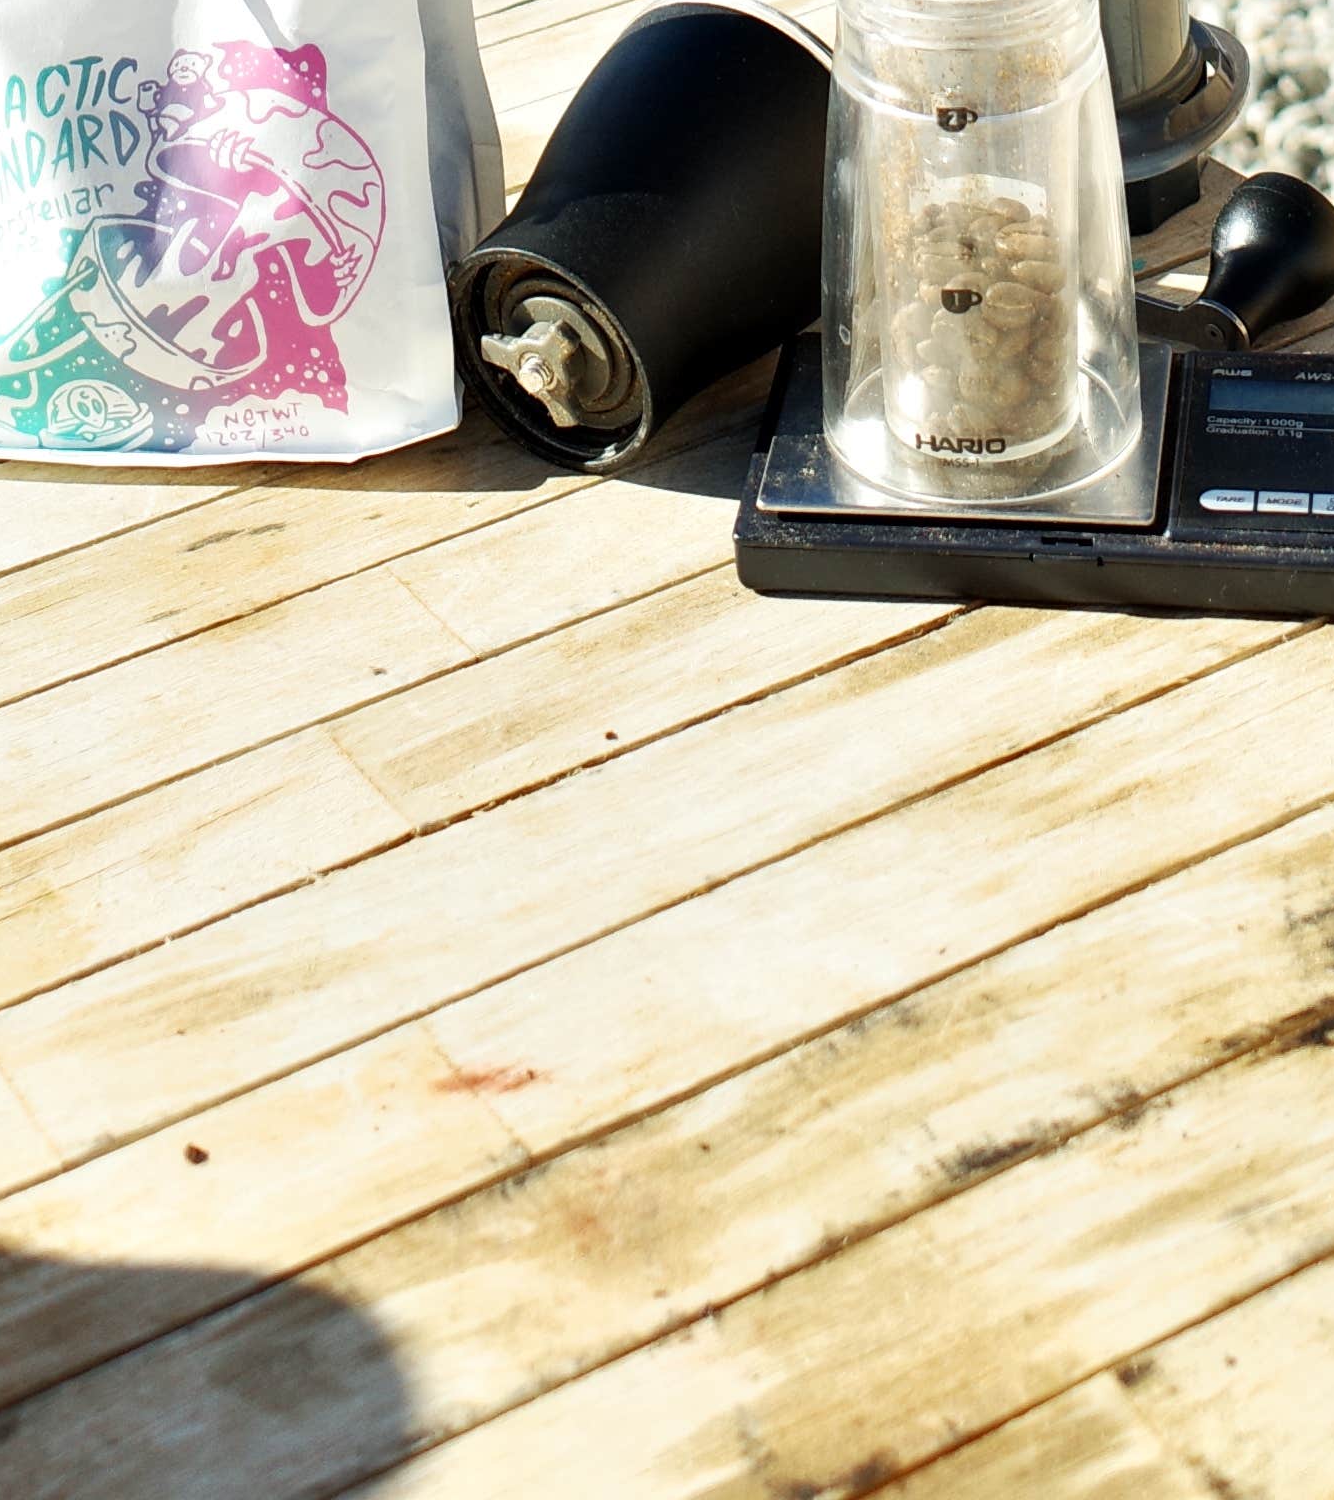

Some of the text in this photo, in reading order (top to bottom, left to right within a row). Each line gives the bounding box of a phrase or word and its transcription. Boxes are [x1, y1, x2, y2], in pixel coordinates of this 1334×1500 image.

[1206, 414, 1304, 429] Capacity: 1000g
[1277, 428, 1304, 439] 0.1g
[914, 432, 1007, 455] HARIO
[1216, 495, 1246, 504] TARE
[1266, 497, 1303, 507] MODE
